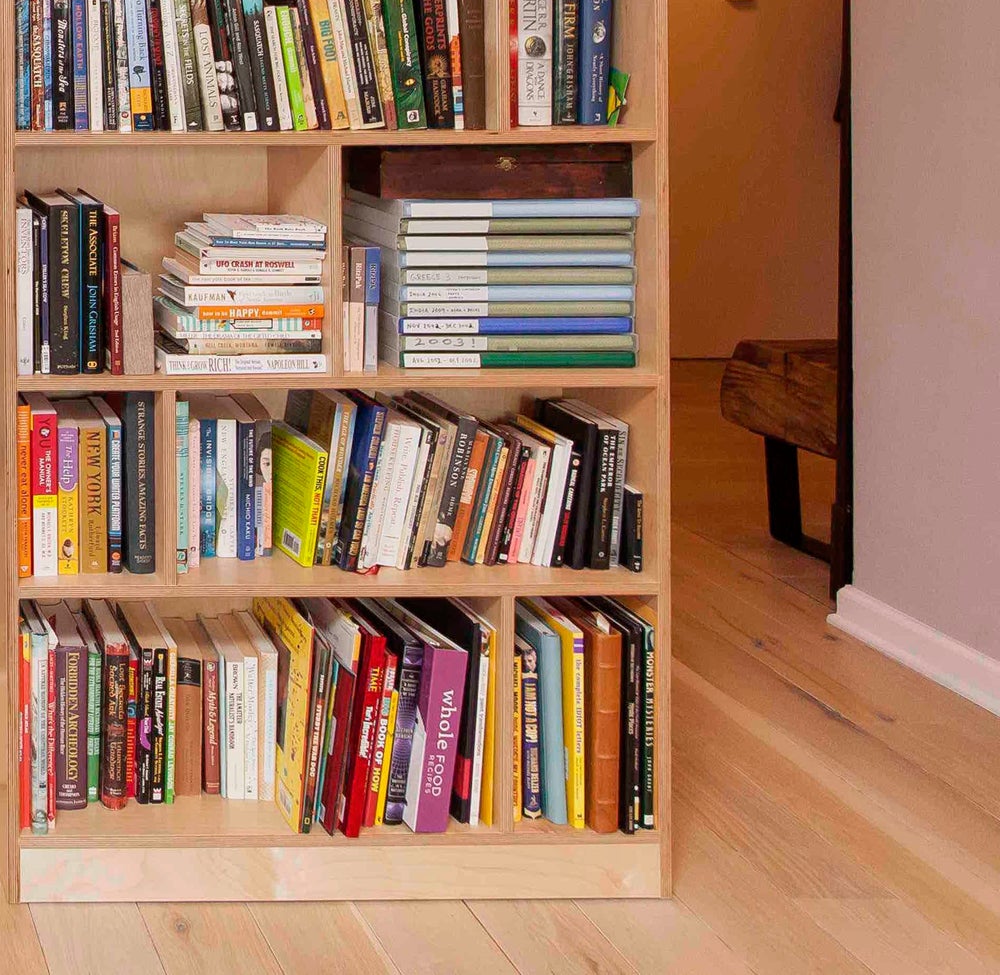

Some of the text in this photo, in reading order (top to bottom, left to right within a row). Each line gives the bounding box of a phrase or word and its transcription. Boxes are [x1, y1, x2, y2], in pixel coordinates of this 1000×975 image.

[135, 8, 144, 40] Turning
[424, 17, 434, 51] GODS
[564, 4, 576, 39] FIRM
[137, 42, 146, 61] Back
[199, 31, 217, 108] LOST ANIMALS
[526, 61, 534, 100] DRAGONS
[89, 210, 98, 352] THE ASSOCIATE JOHN GRISHAM
[189, 293, 226, 301] KAUFMAN
[137, 402, 145, 441] STRANGE
[62, 460, 72, 484] Help
[86, 431, 102, 516] NEW YORK
[449, 433, 468, 488] ROBINSON
[138, 482, 146, 522] AMAZING
[368, 667, 379, 692] TIME
[646, 651, 654, 747] MONSTER MYSTERIES
[68, 652, 80, 782] FORBIDDEN ARCHEOLOGY
[371, 719, 388, 792] BOOK OF HOW
[431, 690, 456, 797] whole FOOD
[424, 755, 435, 794] RECIPES
